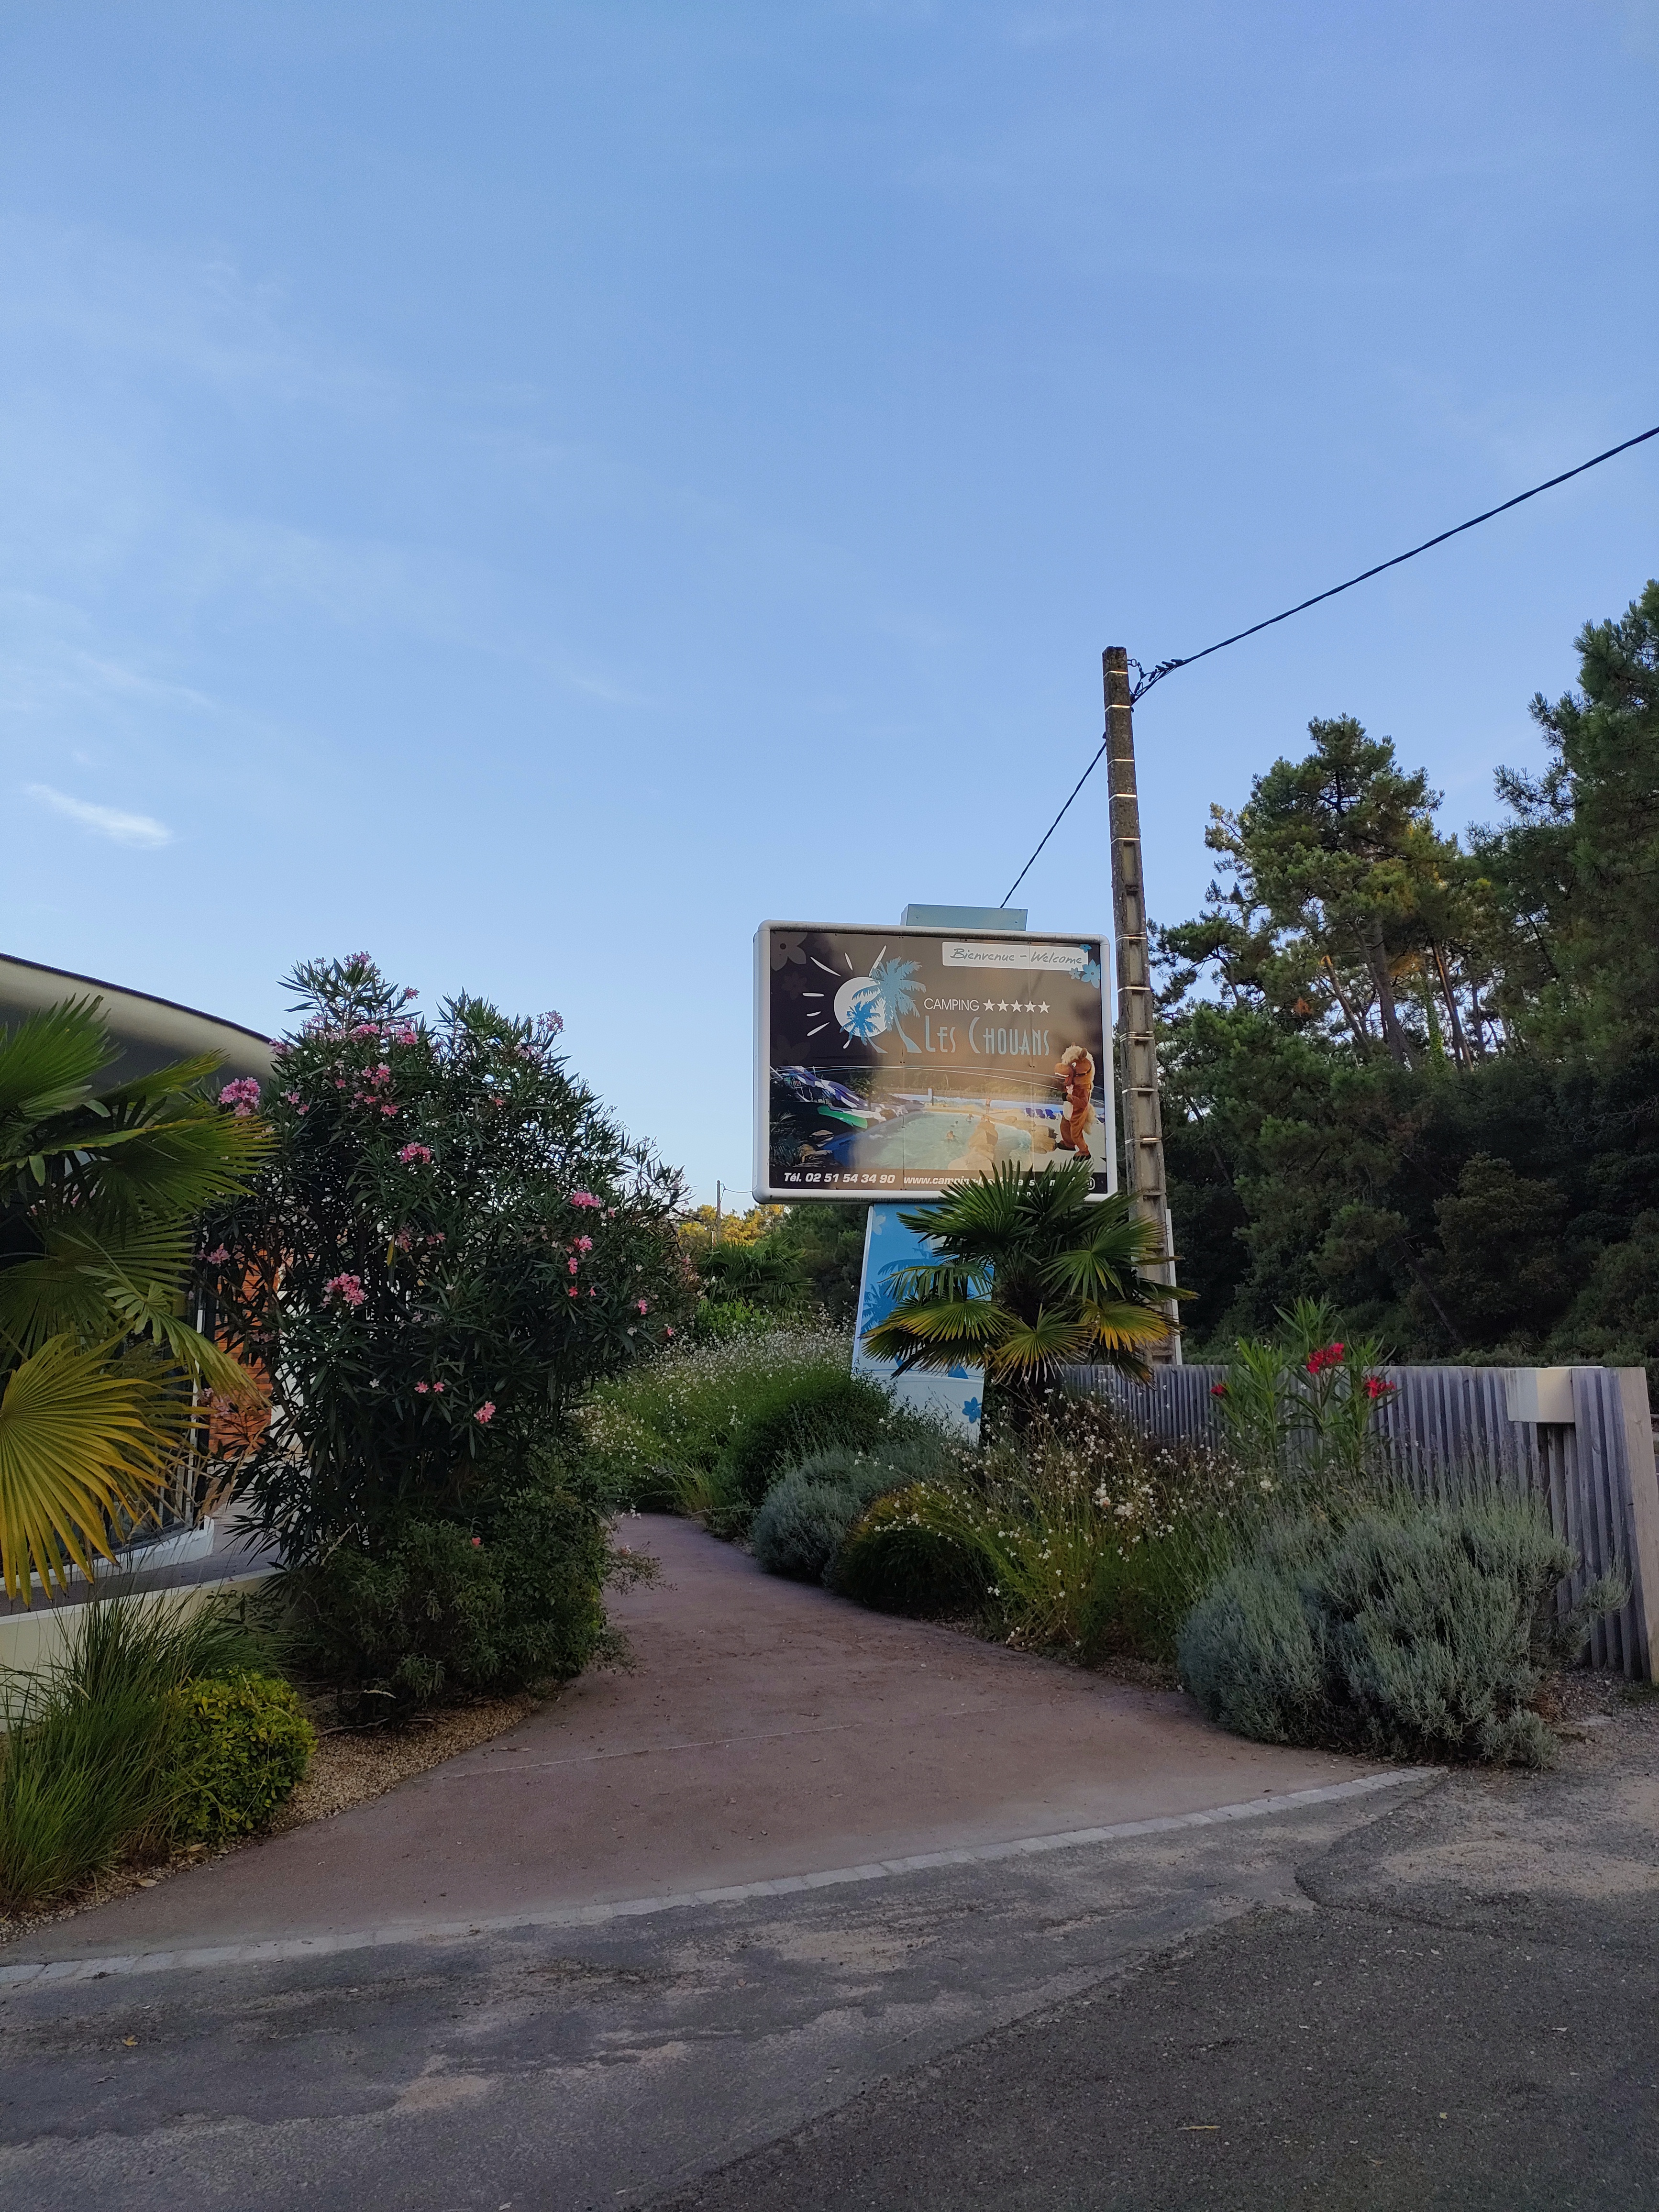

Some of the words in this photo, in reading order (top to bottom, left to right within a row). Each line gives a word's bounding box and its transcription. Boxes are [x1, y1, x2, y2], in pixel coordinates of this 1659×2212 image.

[950, 948, 1015, 962] Bienvenue
[1030, 951, 1082, 964] Welcome
[924, 997, 980, 1012] CAMPING
[784, 1172, 802, 1182] Tél.
[805, 1172, 822, 1183] 02
[824, 1173, 839, 1183] 51
[842, 1173, 859, 1183] 54
[861, 1174, 877, 1183] 34
[879, 1174, 896, 1183] 90
